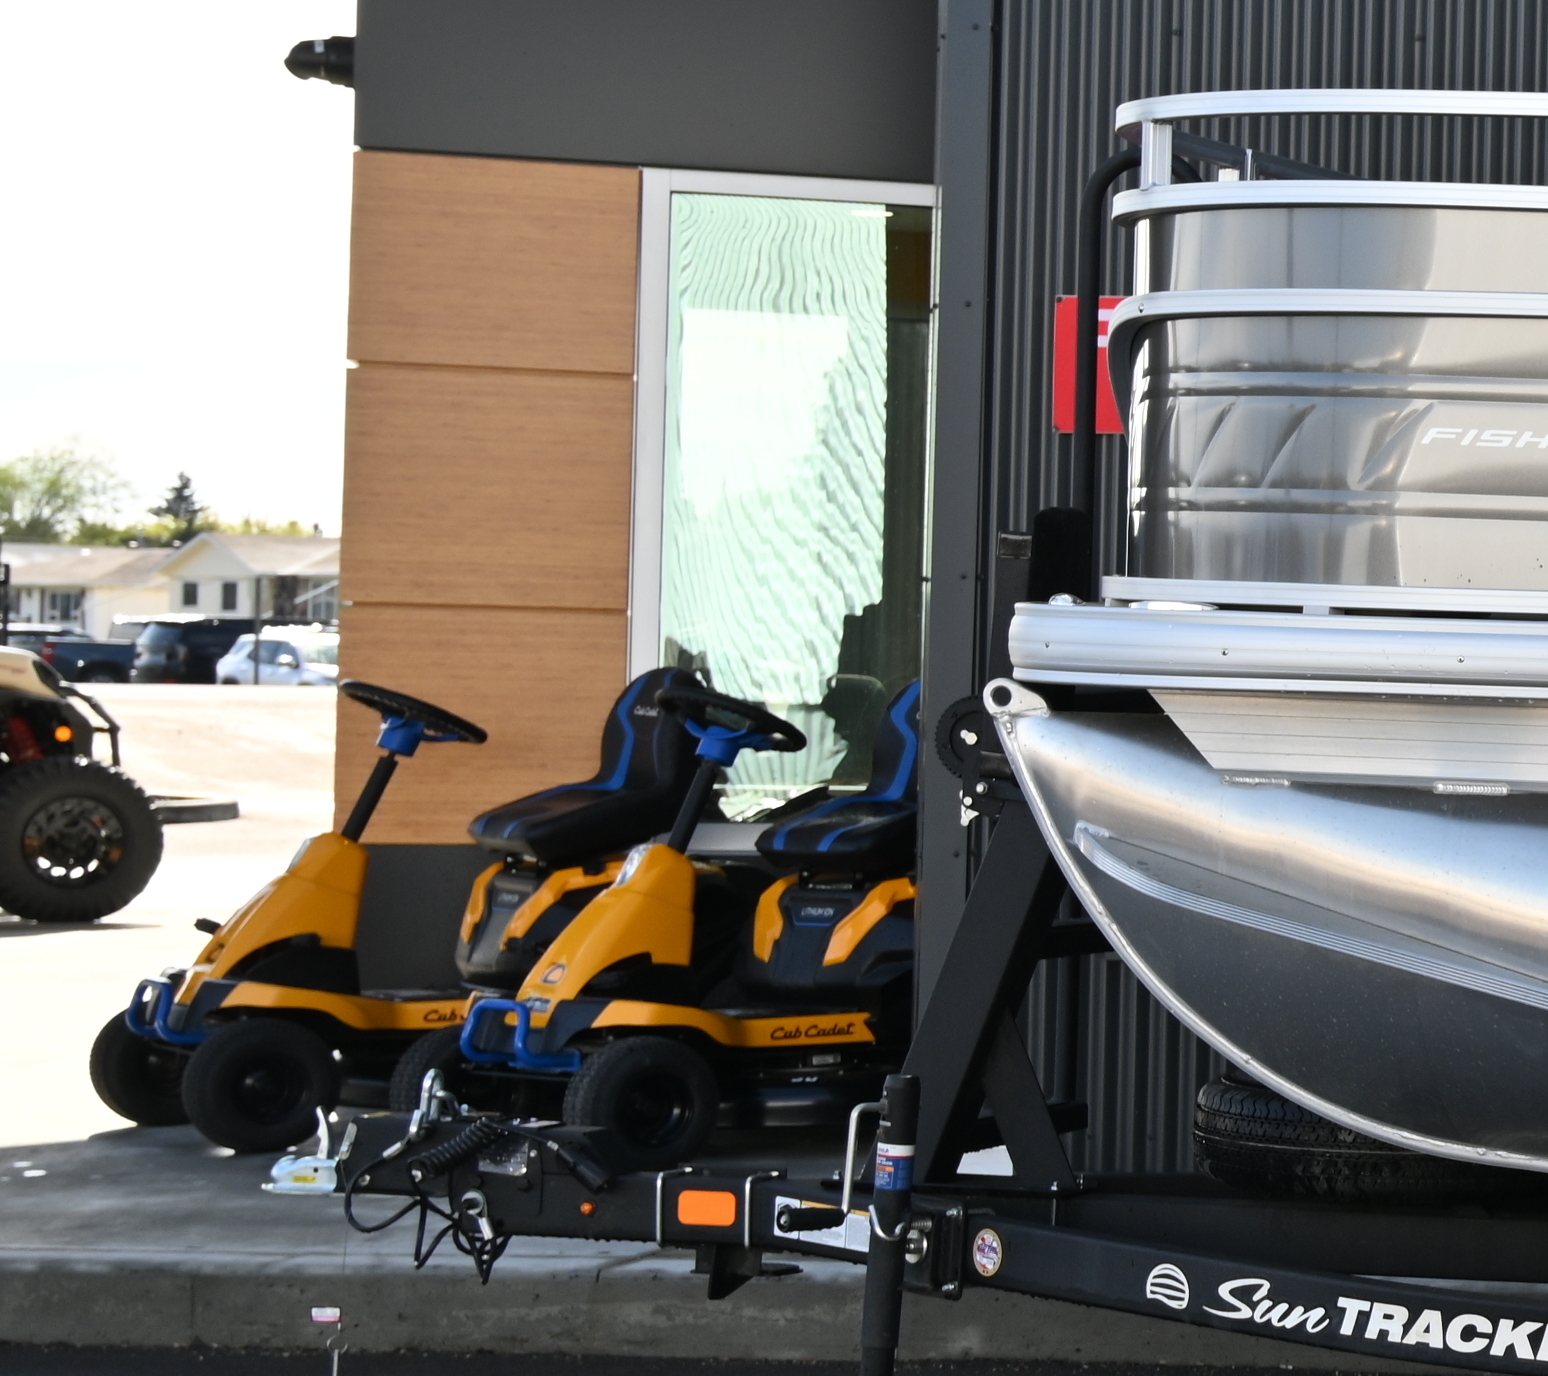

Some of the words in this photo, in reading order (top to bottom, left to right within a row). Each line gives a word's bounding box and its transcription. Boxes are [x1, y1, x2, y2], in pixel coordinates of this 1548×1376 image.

[423, 1008, 458, 1023] Cub
[770, 1026, 802, 1040] Cub
[804, 1022, 856, 1038] Cadet
[1203, 1277, 1329, 1334] Sun
